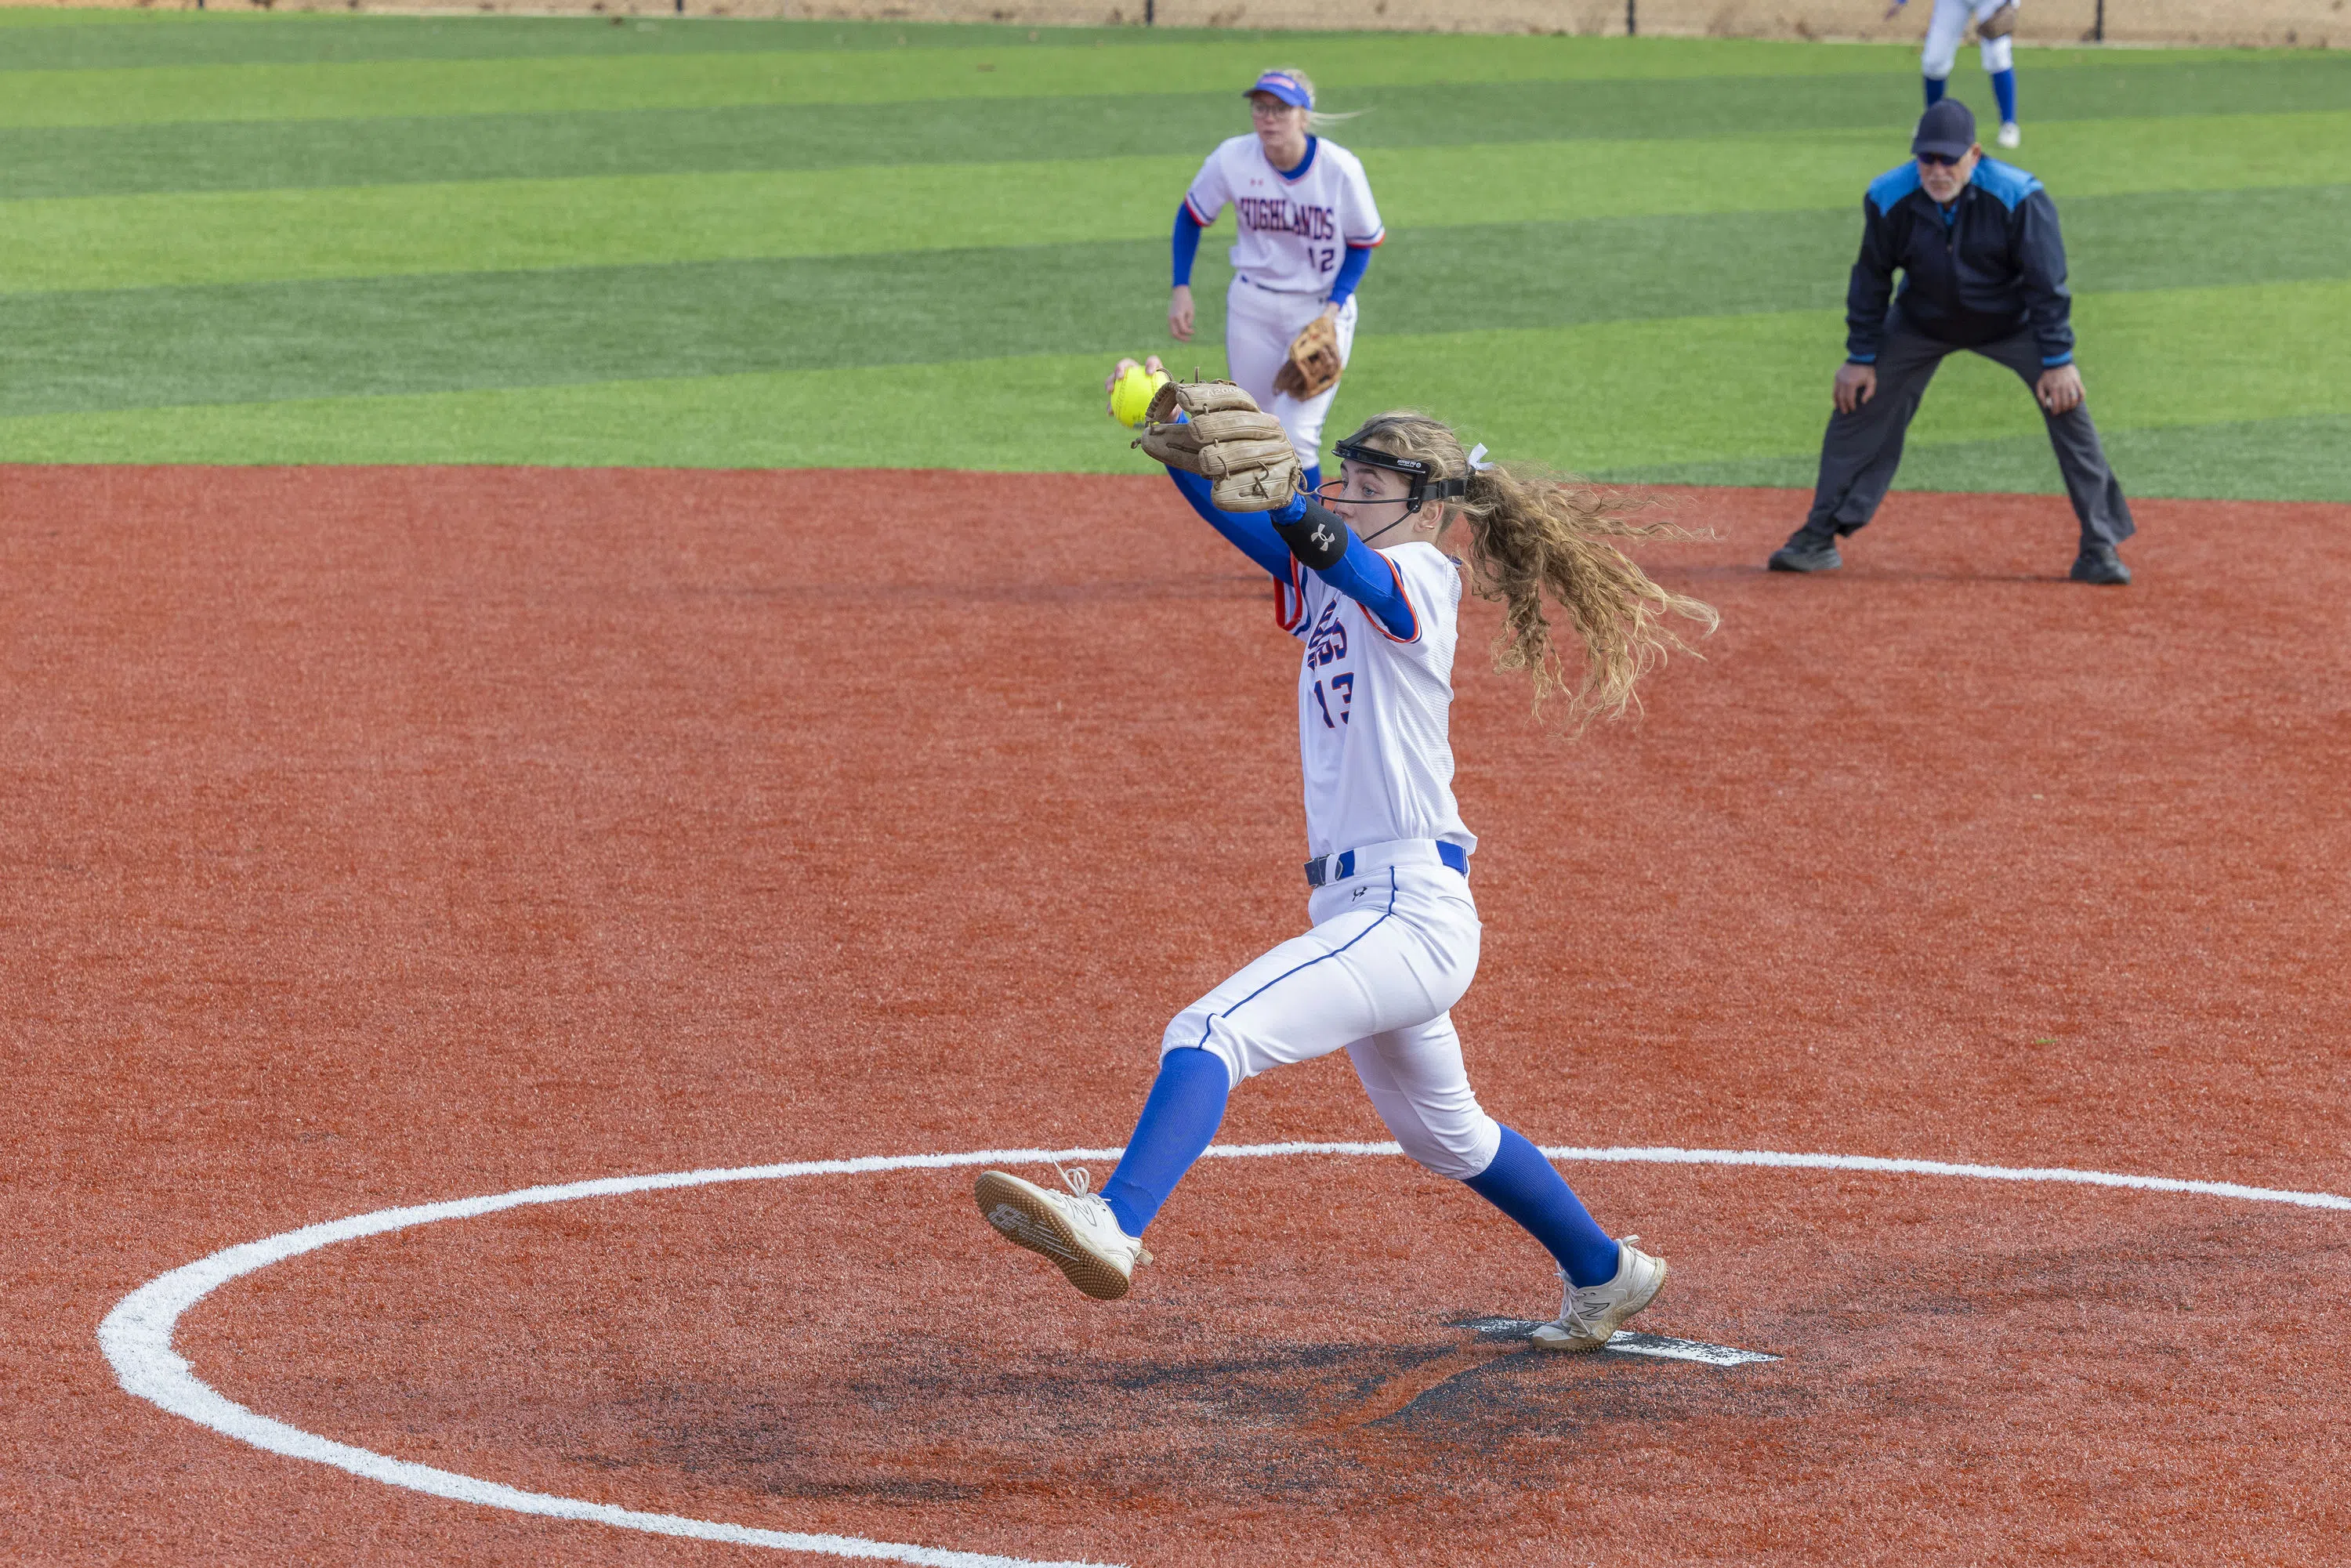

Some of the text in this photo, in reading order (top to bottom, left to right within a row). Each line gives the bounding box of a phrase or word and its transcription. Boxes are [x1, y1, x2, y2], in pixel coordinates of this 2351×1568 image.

[1240, 197, 1335, 241] HIGHLANDS
[1307, 247, 1335, 273] 12
[1313, 672, 1354, 729] 13
